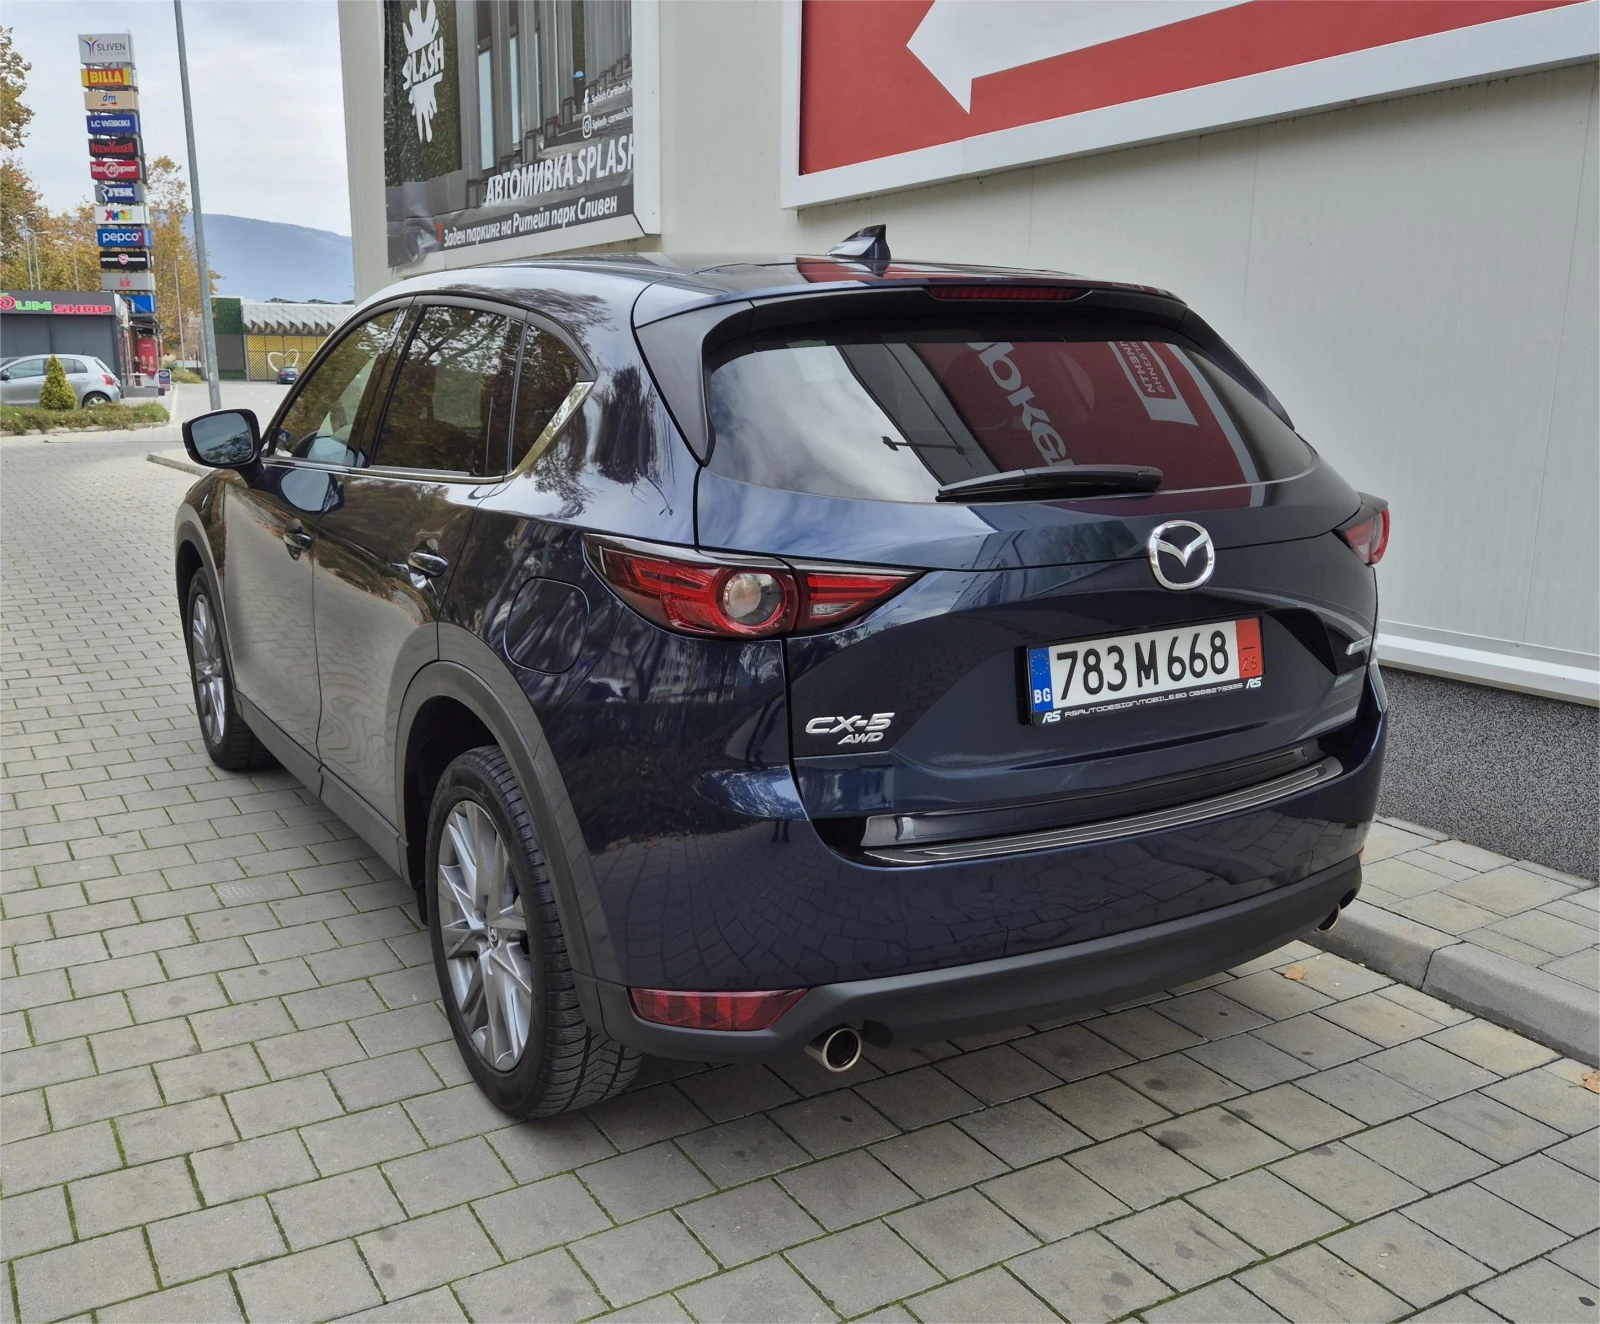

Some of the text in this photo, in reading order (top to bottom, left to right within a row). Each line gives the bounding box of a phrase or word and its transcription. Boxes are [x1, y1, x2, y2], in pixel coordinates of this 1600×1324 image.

[97, 43, 126, 52] SLIVEN
[89, 71, 122, 84] BILLA
[102, 93, 116, 102] dm
[91, 120, 101, 128] LC
[485, 153, 574, 206] АВТОМИВКА
[107, 187, 134, 197] JYSK
[444, 196, 618, 247] Заден паркинг на Ритейл парк Сливен
[102, 232, 139, 243] pepco
[53, 304, 112, 314] SHOP
[1056, 645, 1128, 701] 783
[1167, 630, 1229, 682] 668
[1034, 687, 1051, 704] BG
[805, 712, 895, 734] CX-5
[837, 731, 884, 745] AWD
